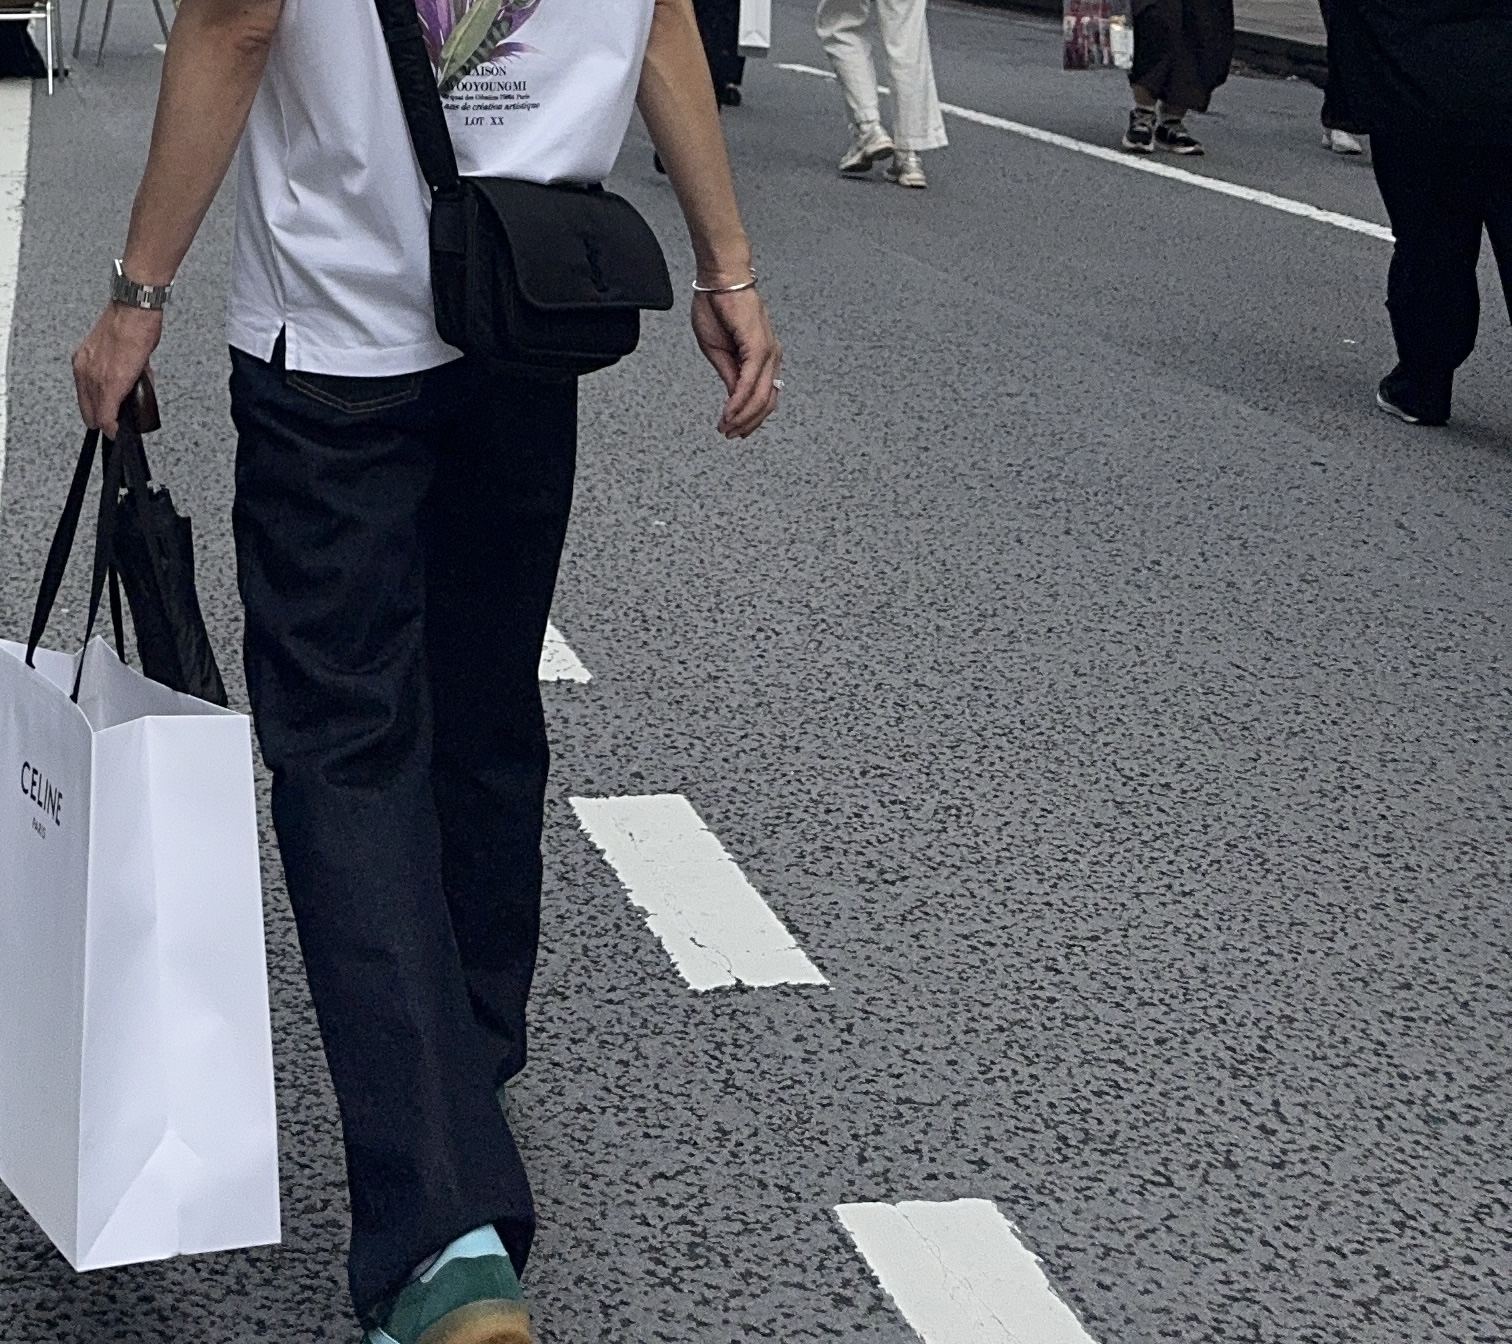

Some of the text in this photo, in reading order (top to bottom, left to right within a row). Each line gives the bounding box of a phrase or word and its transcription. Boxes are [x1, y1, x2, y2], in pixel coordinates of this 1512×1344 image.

[464, 116, 505, 126] LOT XX
[21, 761, 64, 827] CELINE
